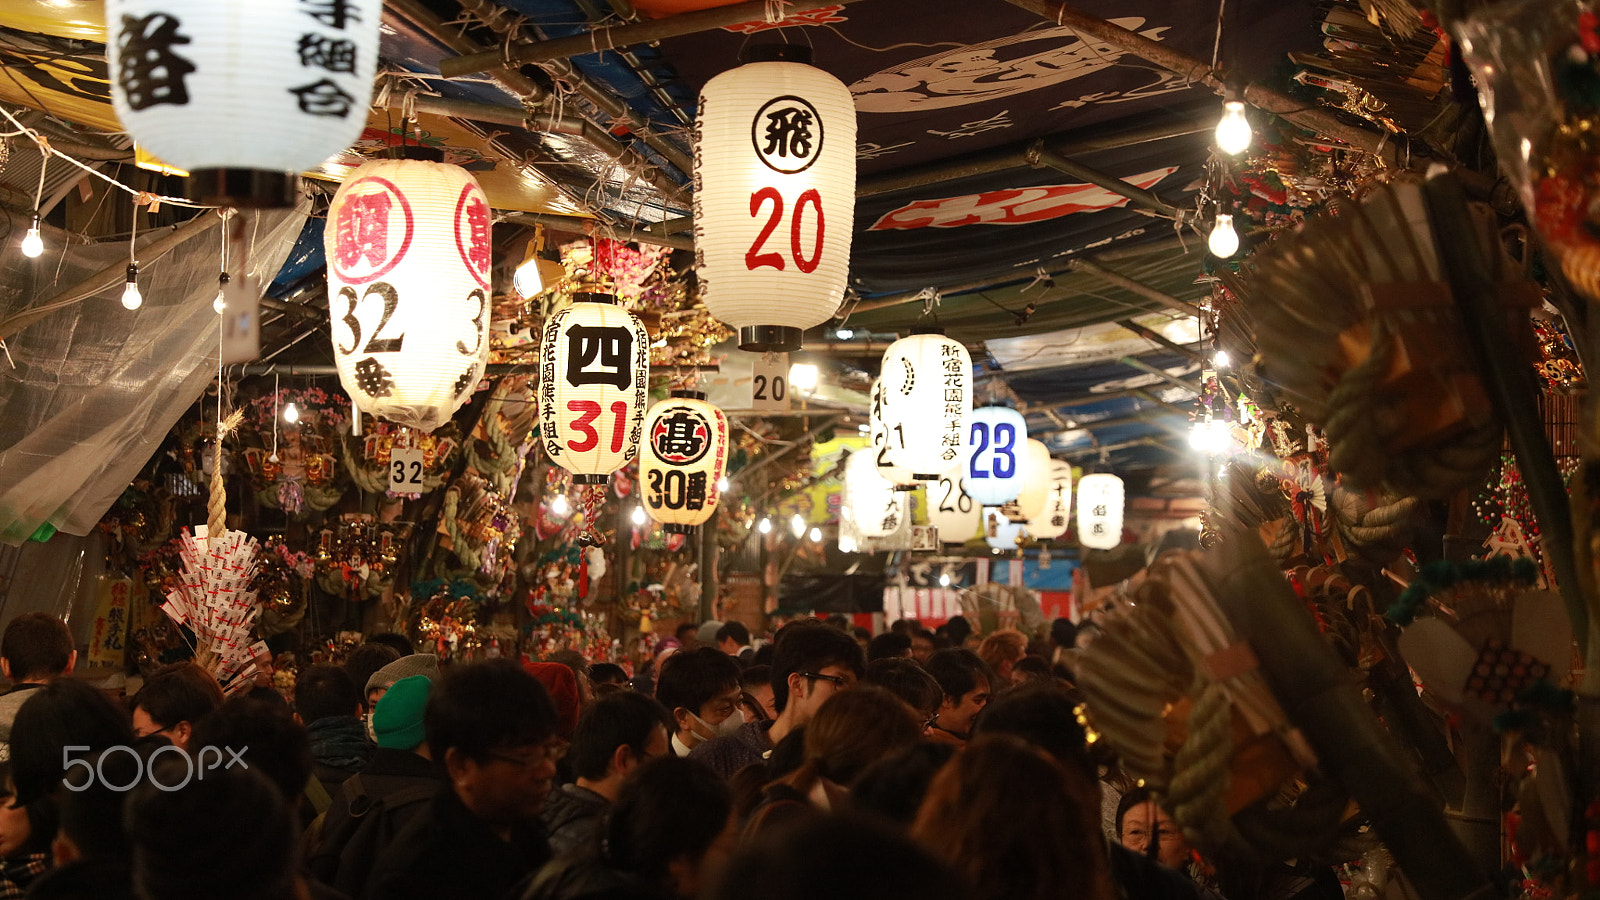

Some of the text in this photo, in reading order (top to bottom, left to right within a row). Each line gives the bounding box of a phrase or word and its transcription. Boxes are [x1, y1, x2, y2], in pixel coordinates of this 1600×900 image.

[118, 11, 199, 112] 番
[763, 107, 813, 158] 飛
[744, 186, 825, 274] 20
[336, 281, 405, 355] 32
[565, 323, 634, 392] 四
[754, 374, 785, 401] 20
[940, 344, 964, 461] 新宿花園熊手組合
[566, 400, 628, 453] 31
[969, 421, 1016, 479] 23
[393, 459, 422, 484] 32
[647, 468, 707, 511] 30番
[938, 477, 973, 514] 28
